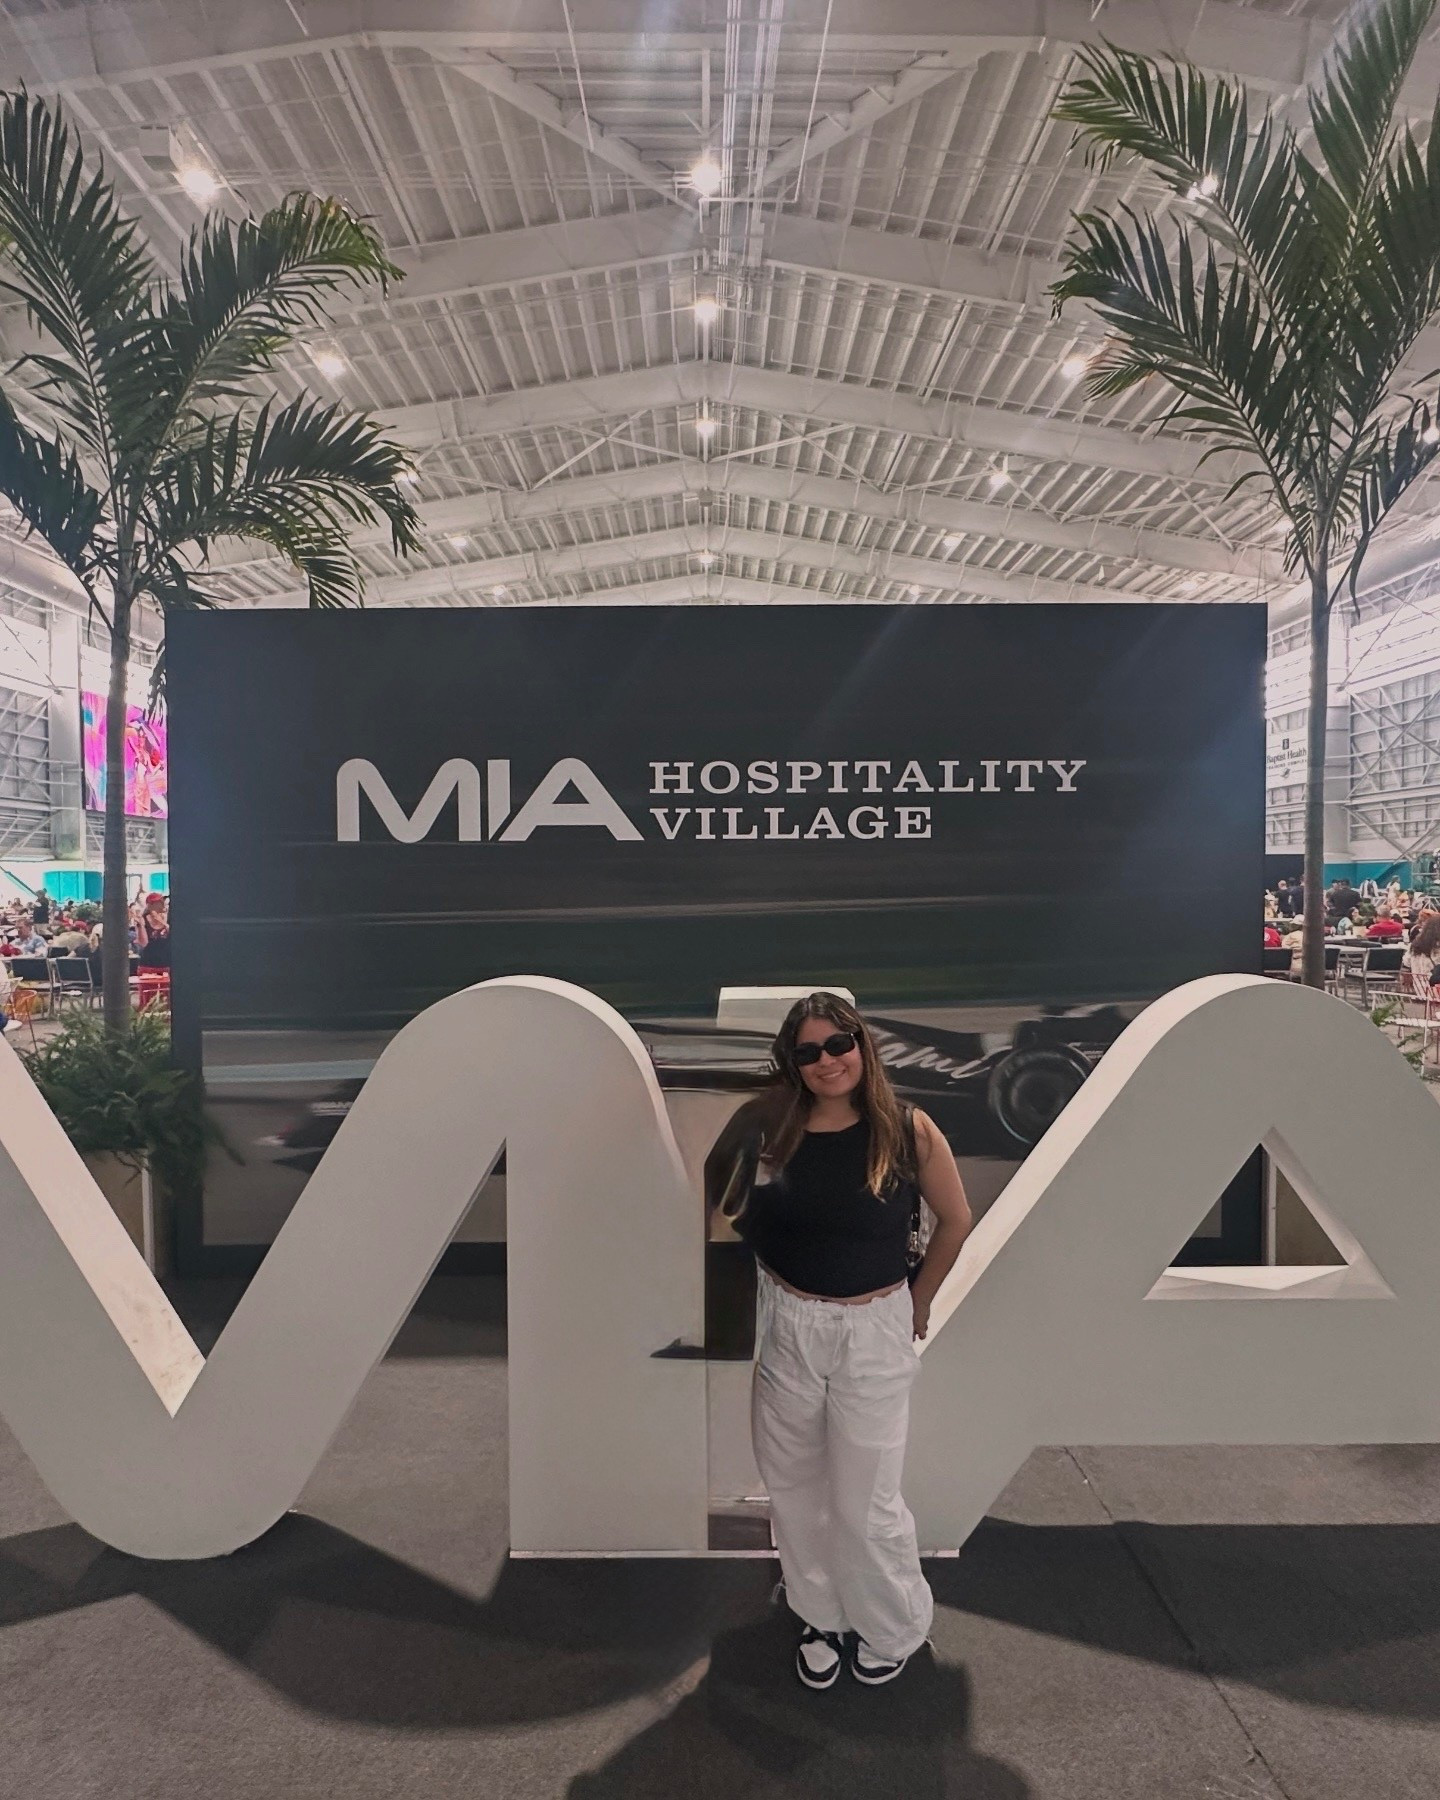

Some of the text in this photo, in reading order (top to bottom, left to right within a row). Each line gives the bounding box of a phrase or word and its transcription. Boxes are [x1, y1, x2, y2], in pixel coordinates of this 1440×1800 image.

[1287, 747, 1308, 760] Health
[649, 760, 1087, 795] HOSPITALITY
[336, 758, 644, 843] MIA
[649, 805, 932, 840] VILLAGE
